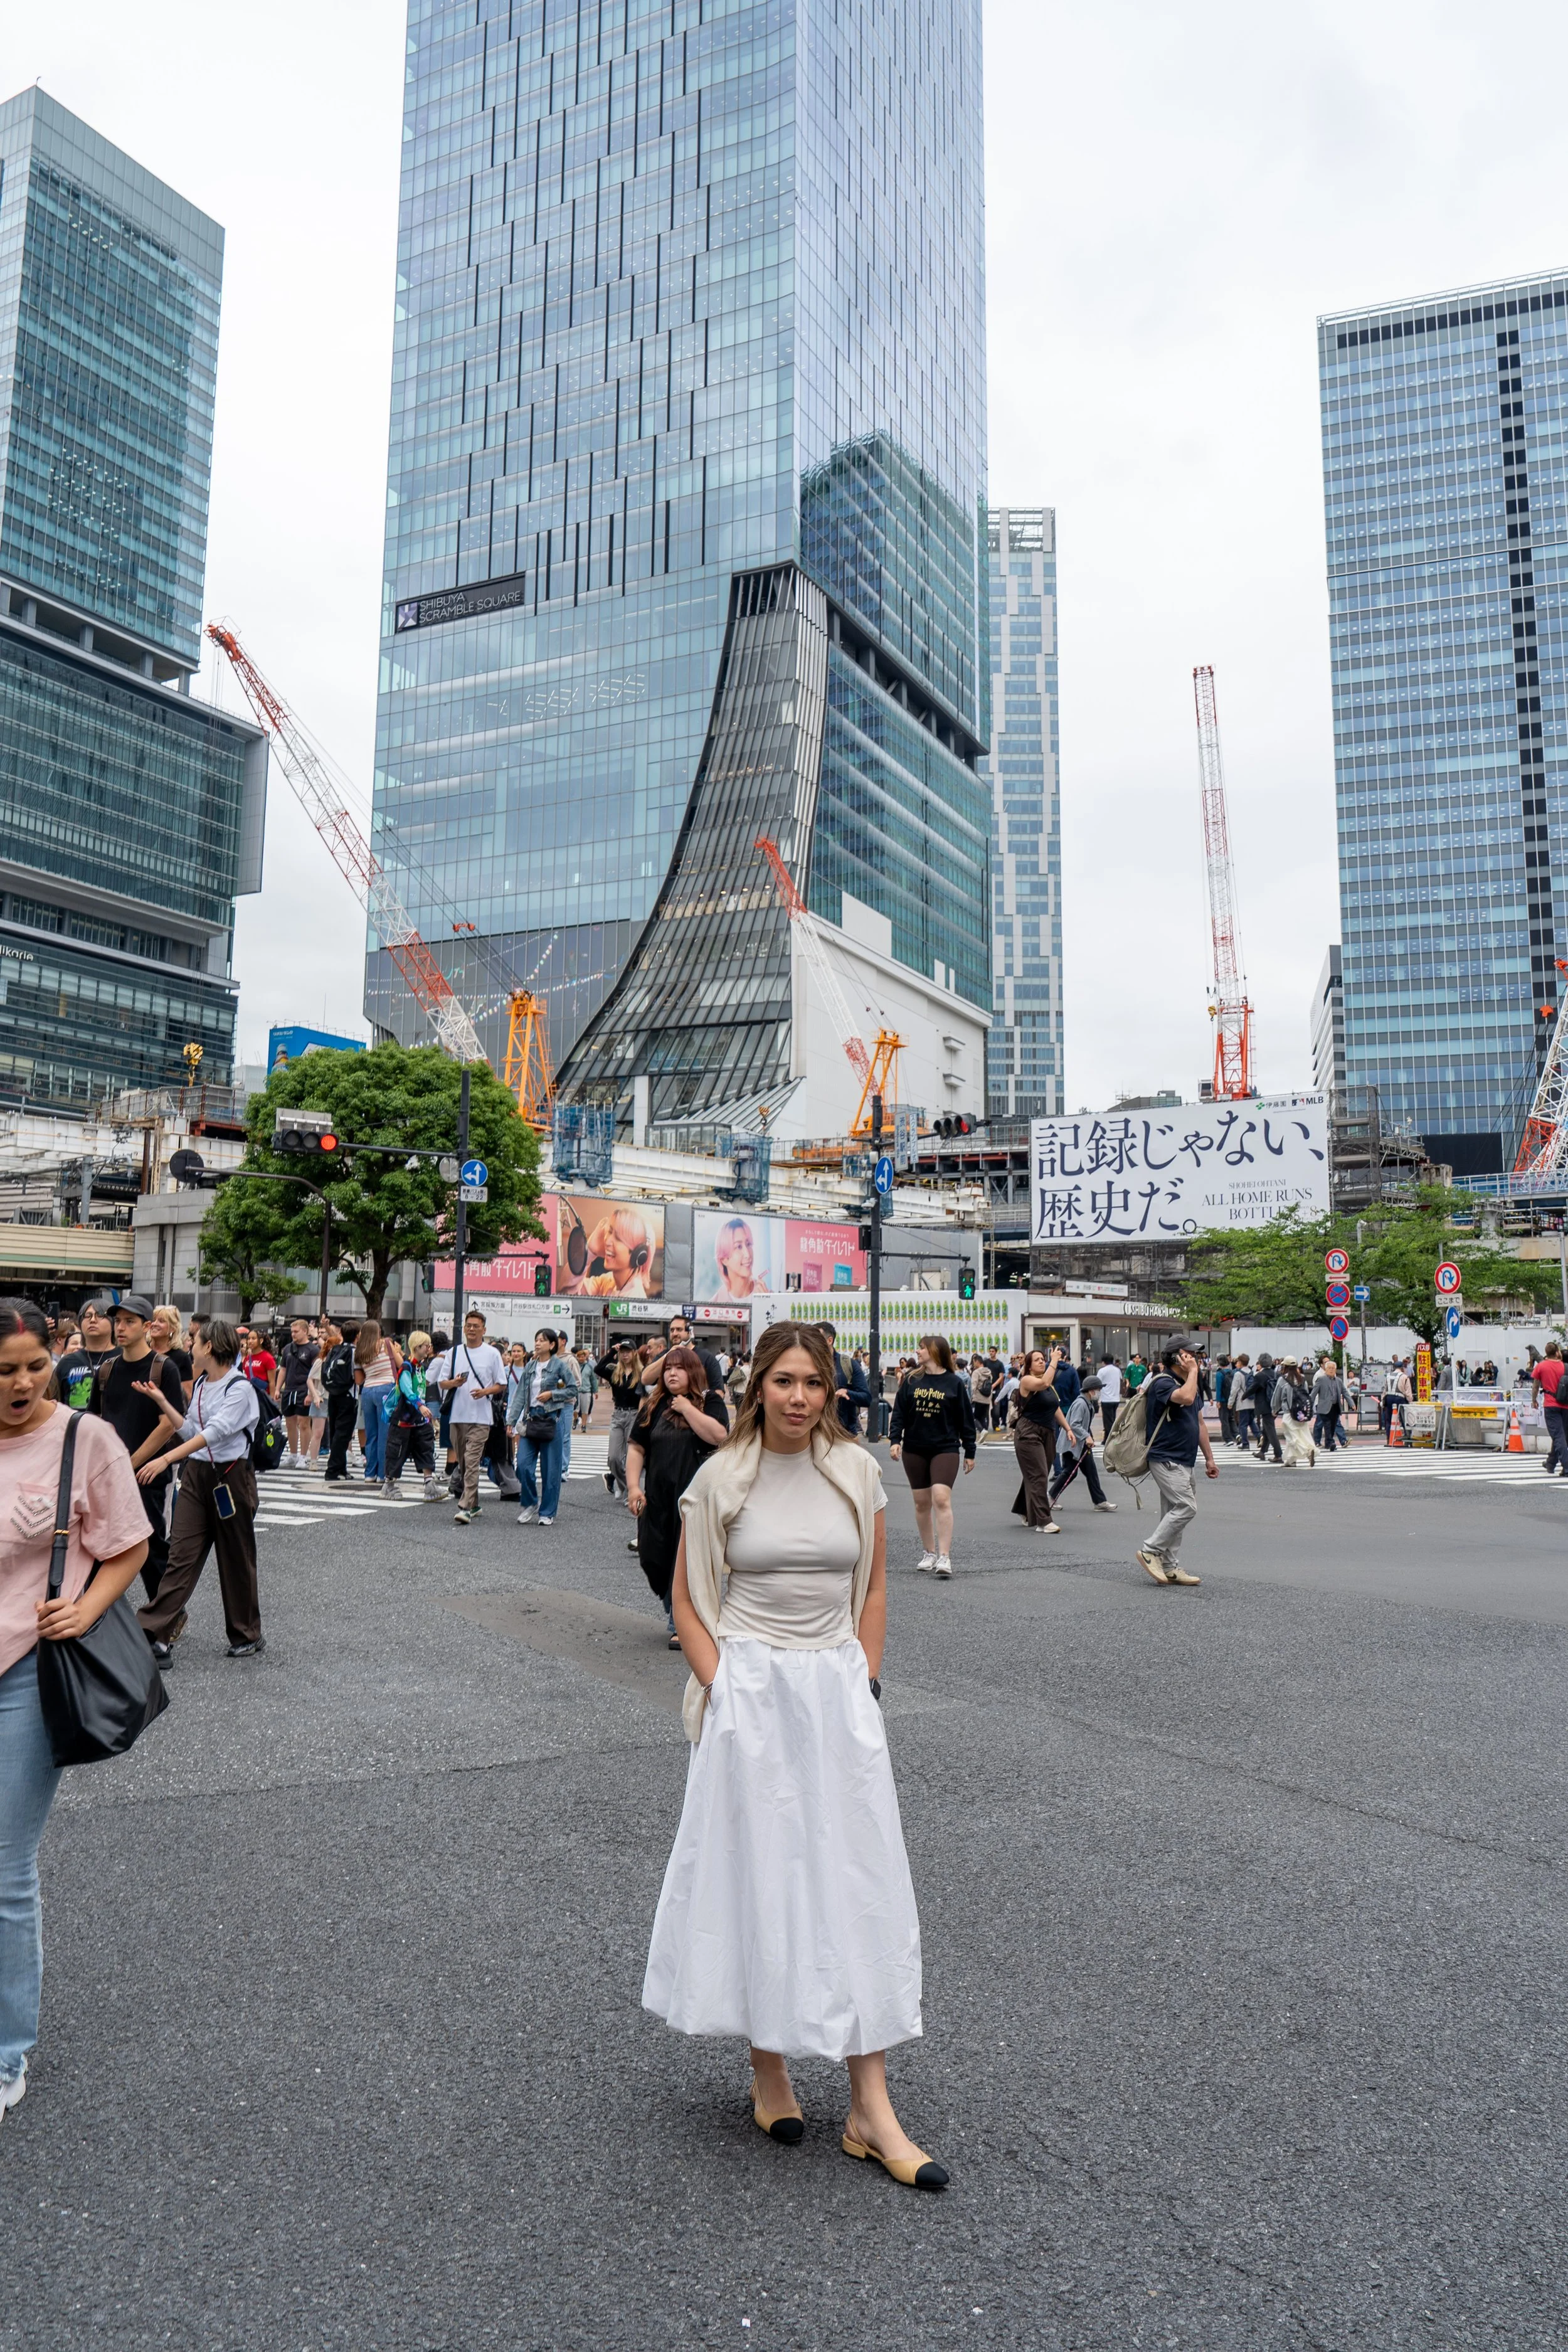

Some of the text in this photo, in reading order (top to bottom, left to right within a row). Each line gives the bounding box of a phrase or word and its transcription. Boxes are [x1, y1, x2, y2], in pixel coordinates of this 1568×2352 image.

[419, 590, 521, 623] SCRAMBLE SQUARE
[420, 592, 465, 612] SHIBUYA
[0, 945, 33, 961] ikarie
[1306, 1096, 1323, 1104] MLB
[1036, 1110, 1324, 1180] 記録じゃない、
[1229, 1179, 1286, 1190] SHOHEI OHTANI
[1202, 1188, 1313, 1206] ALL HOME RUNS
[1034, 1177, 1197, 1239] 歴史だ。
[617, 1304, 627, 1312] JR
[1418, 1355, 1428, 1402] 駐停車禁
[914, 1388, 945, 1400] Harry Potter
